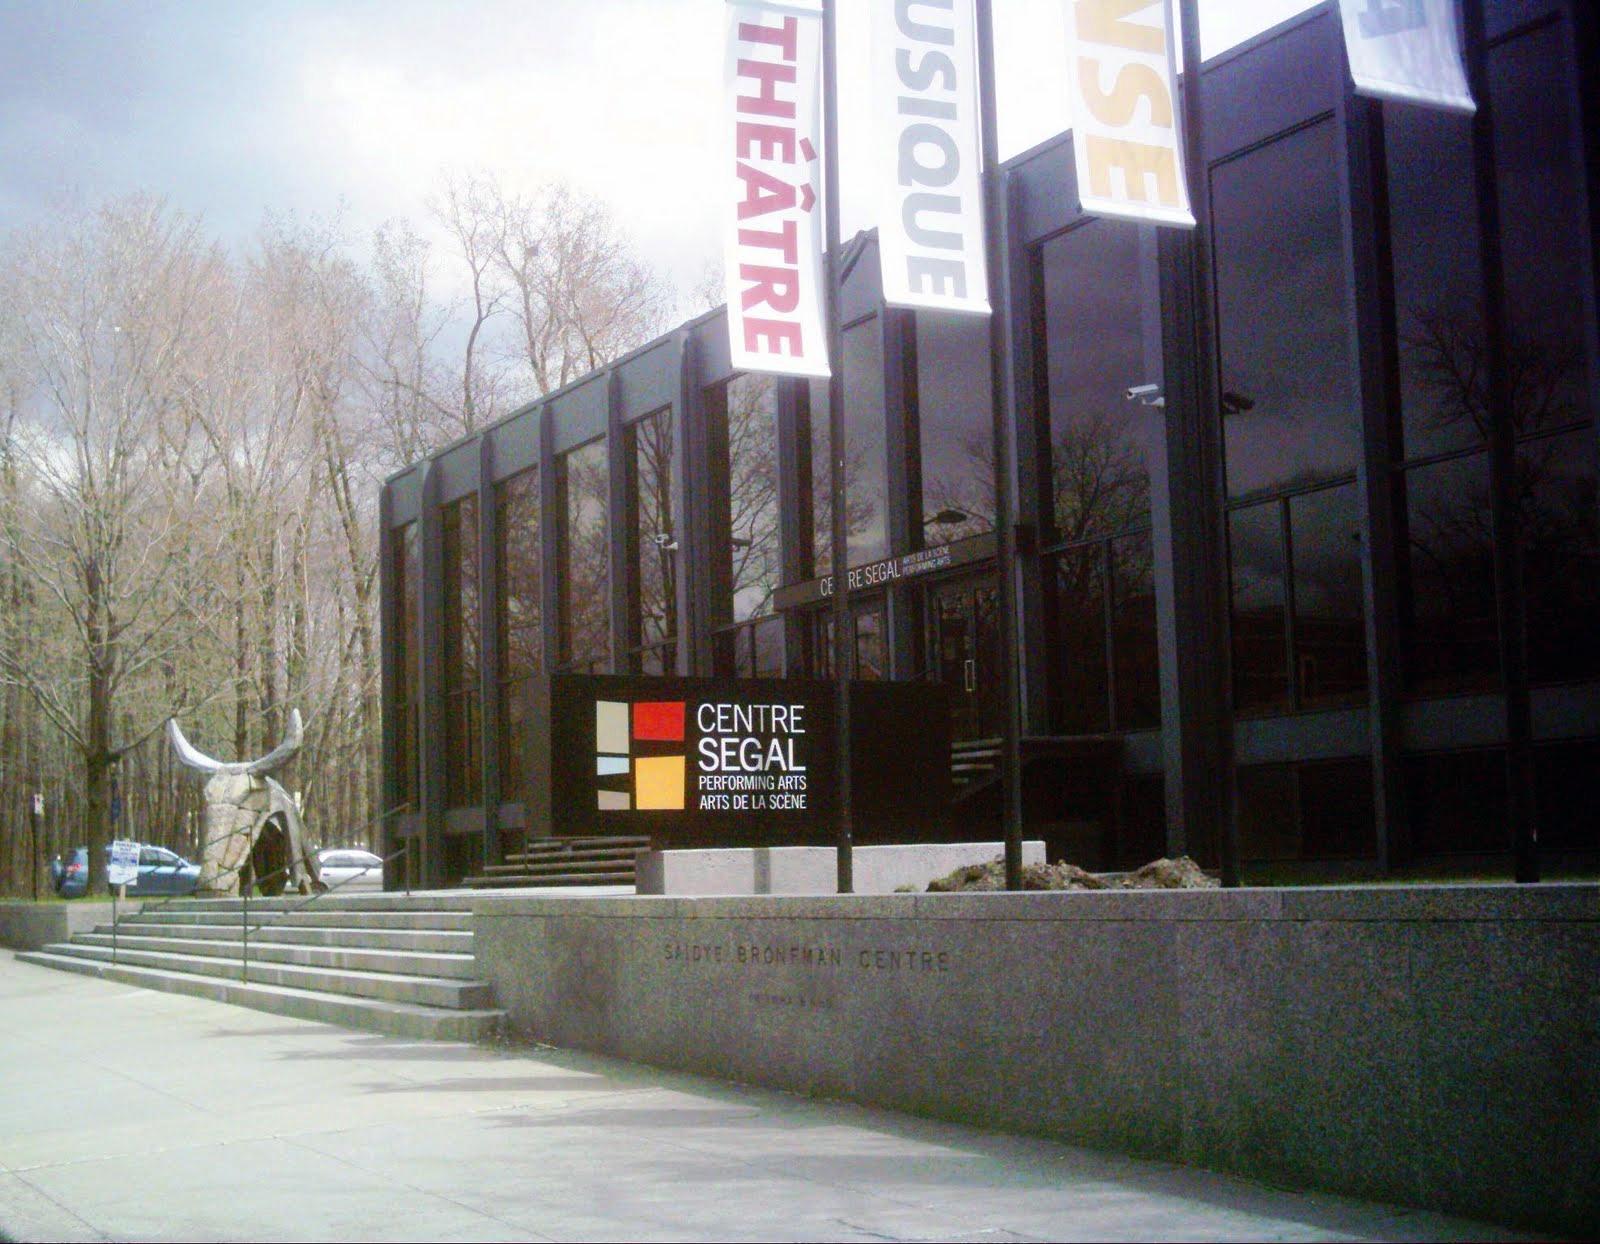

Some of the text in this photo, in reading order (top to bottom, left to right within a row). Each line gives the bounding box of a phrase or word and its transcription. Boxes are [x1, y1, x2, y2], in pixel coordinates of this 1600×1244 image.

[736, 16, 817, 358] THÉÂTRE
[819, 559, 901, 597] CERE SEGAL
[697, 703, 806, 733] CENTRE
[698, 737, 807, 772] SEGAL
[699, 775, 807, 791] PERFORMING ARTS
[700, 791, 807, 810] ARTS DE LA SCÈNE
[736, 945, 842, 967] BRONFMAN
[858, 949, 950, 973] CENTRE
